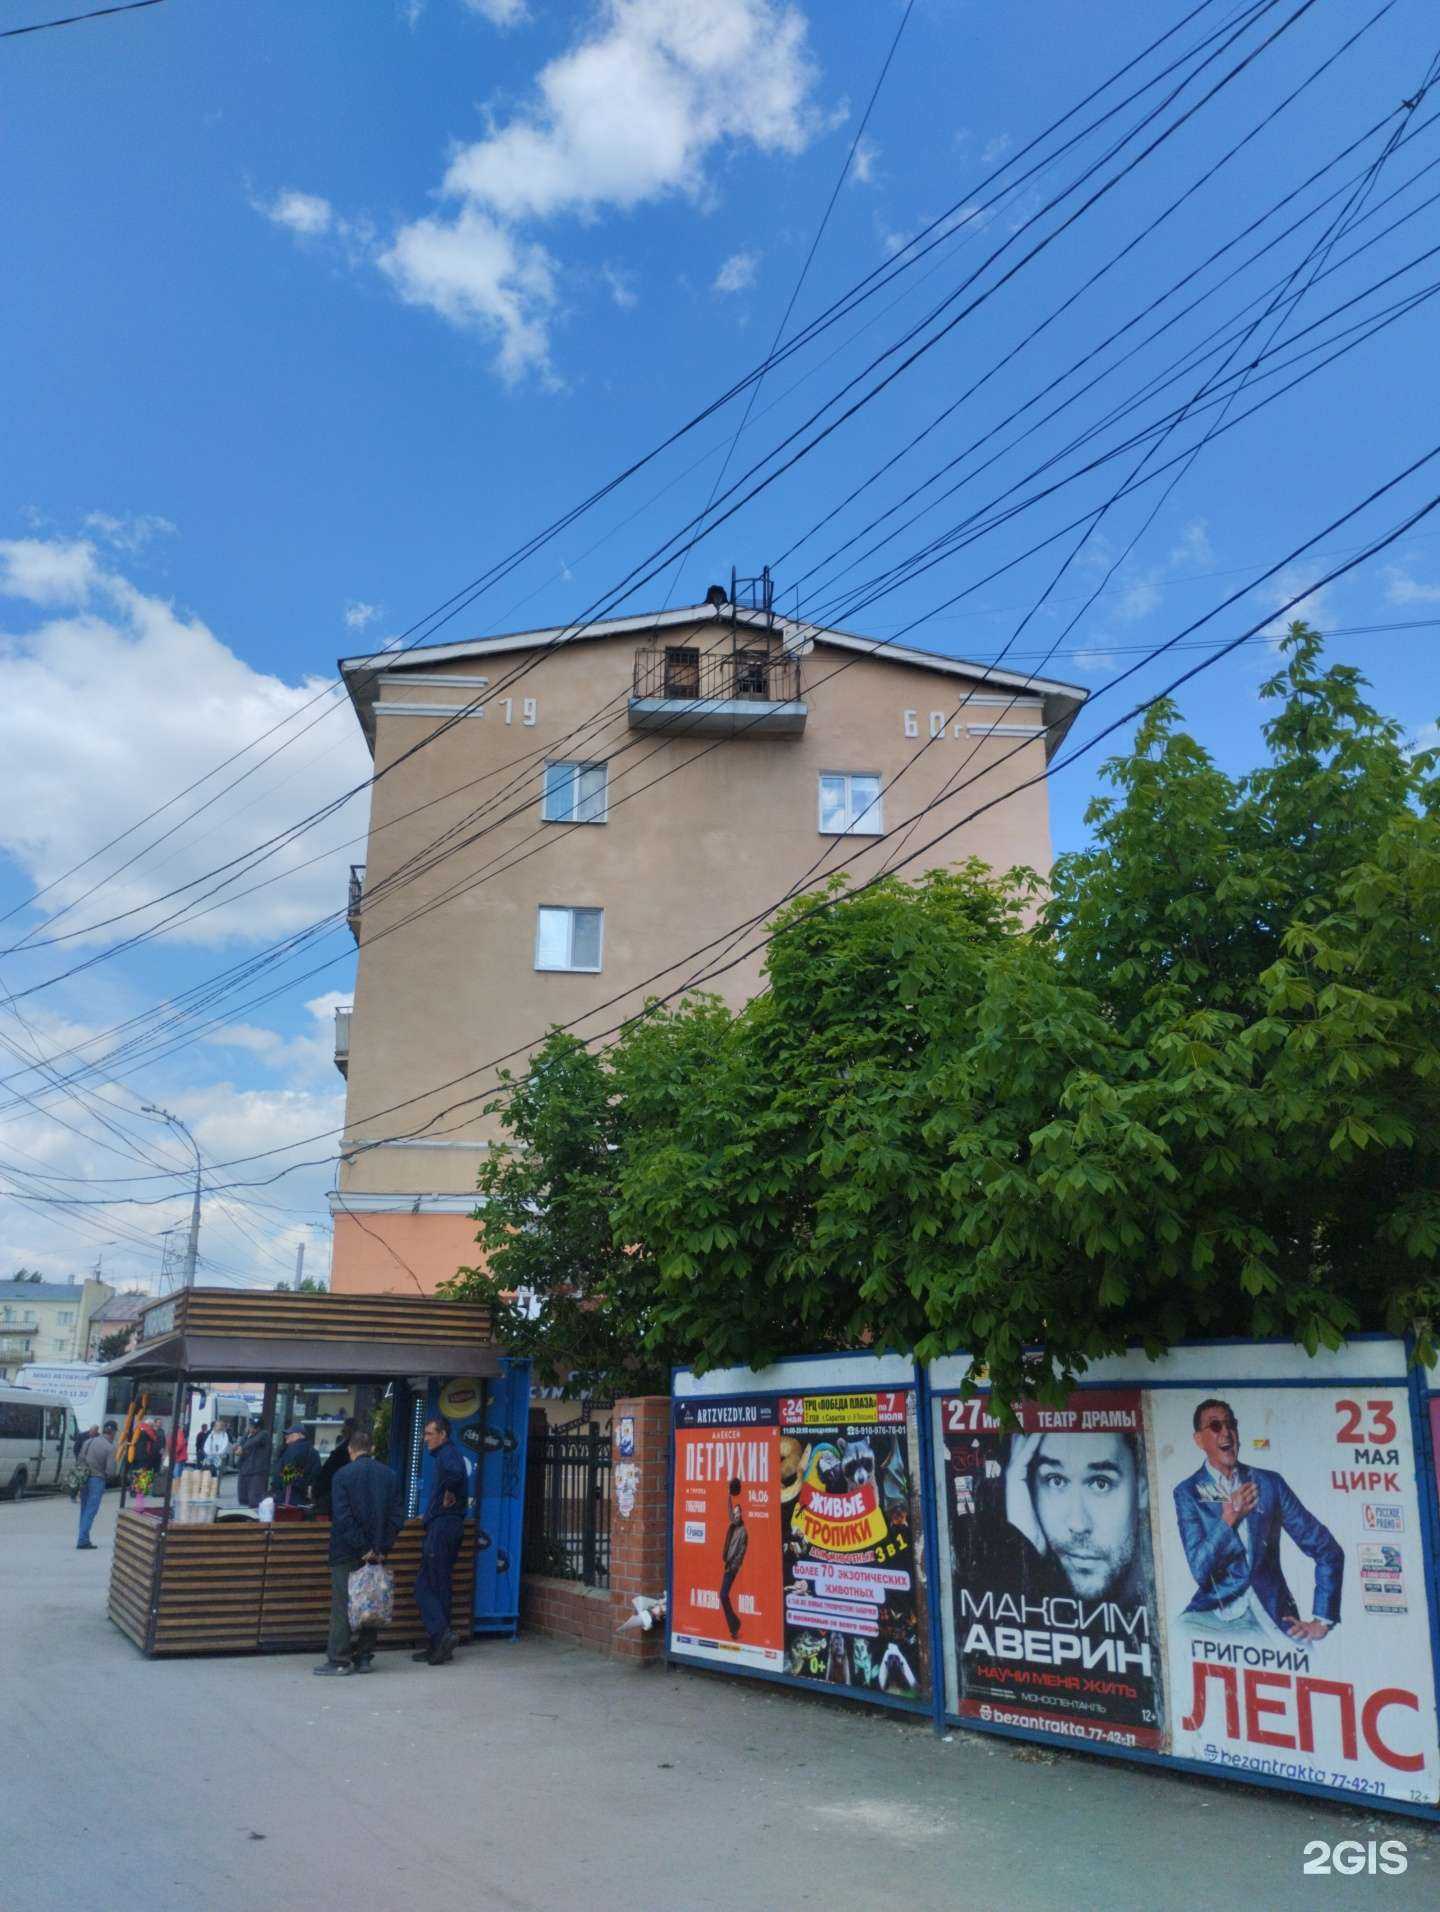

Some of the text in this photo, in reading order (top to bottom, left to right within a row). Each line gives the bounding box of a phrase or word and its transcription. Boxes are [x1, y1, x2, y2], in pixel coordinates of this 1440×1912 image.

[498, 698, 537, 726] 19
[697, 1406, 757, 1424] ARTZVEZDY.RU
[787, 1400, 803, 1415] 24
[886, 1393, 895, 1411] 7
[948, 1399, 982, 1430] 27
[1037, 1411, 1078, 1428] ТЕАТР
[1082, 1410, 1137, 1429] ДРАМЫ
[879, 1412, 903, 1421] ИЮЛЯ
[1335, 1399, 1397, 1445] 23
[685, 1441, 769, 1483] ПЕТРУХИН
[1354, 1448, 1400, 1466] МАЯ
[1331, 1470, 1402, 1494] ЦИРК
[808, 1491, 866, 1518] ЖИВЫЕ
[804, 1516, 873, 1547] ТРОПИКИ
[875, 1546, 886, 1563] 3
[896, 1533, 908, 1550] 1
[793, 1564, 908, 1586] БОЛЕЕ 70 ЭКЗОТИЧЕСКИХ
[825, 1583, 875, 1599] ЖИВОТНЫХ
[960, 1588, 1150, 1637] МАКСИМ
[963, 1623, 1152, 1678] АВЕРИН
[1191, 1639, 1311, 1673] ГРИГОРИЙ
[976, 1664, 1137, 1699] НАУЧИ МЕНЯ ЖИТЬ
[994, 1709, 1085, 1738] bezantrakta
[1141, 1709, 1157, 1723] 12+
[1182, 1661, 1426, 1773] ЛЕПС
[1221, 1748, 1386, 1795] bezantrakta 77-42-11
[1410, 1789, 1431, 1801] 12+
